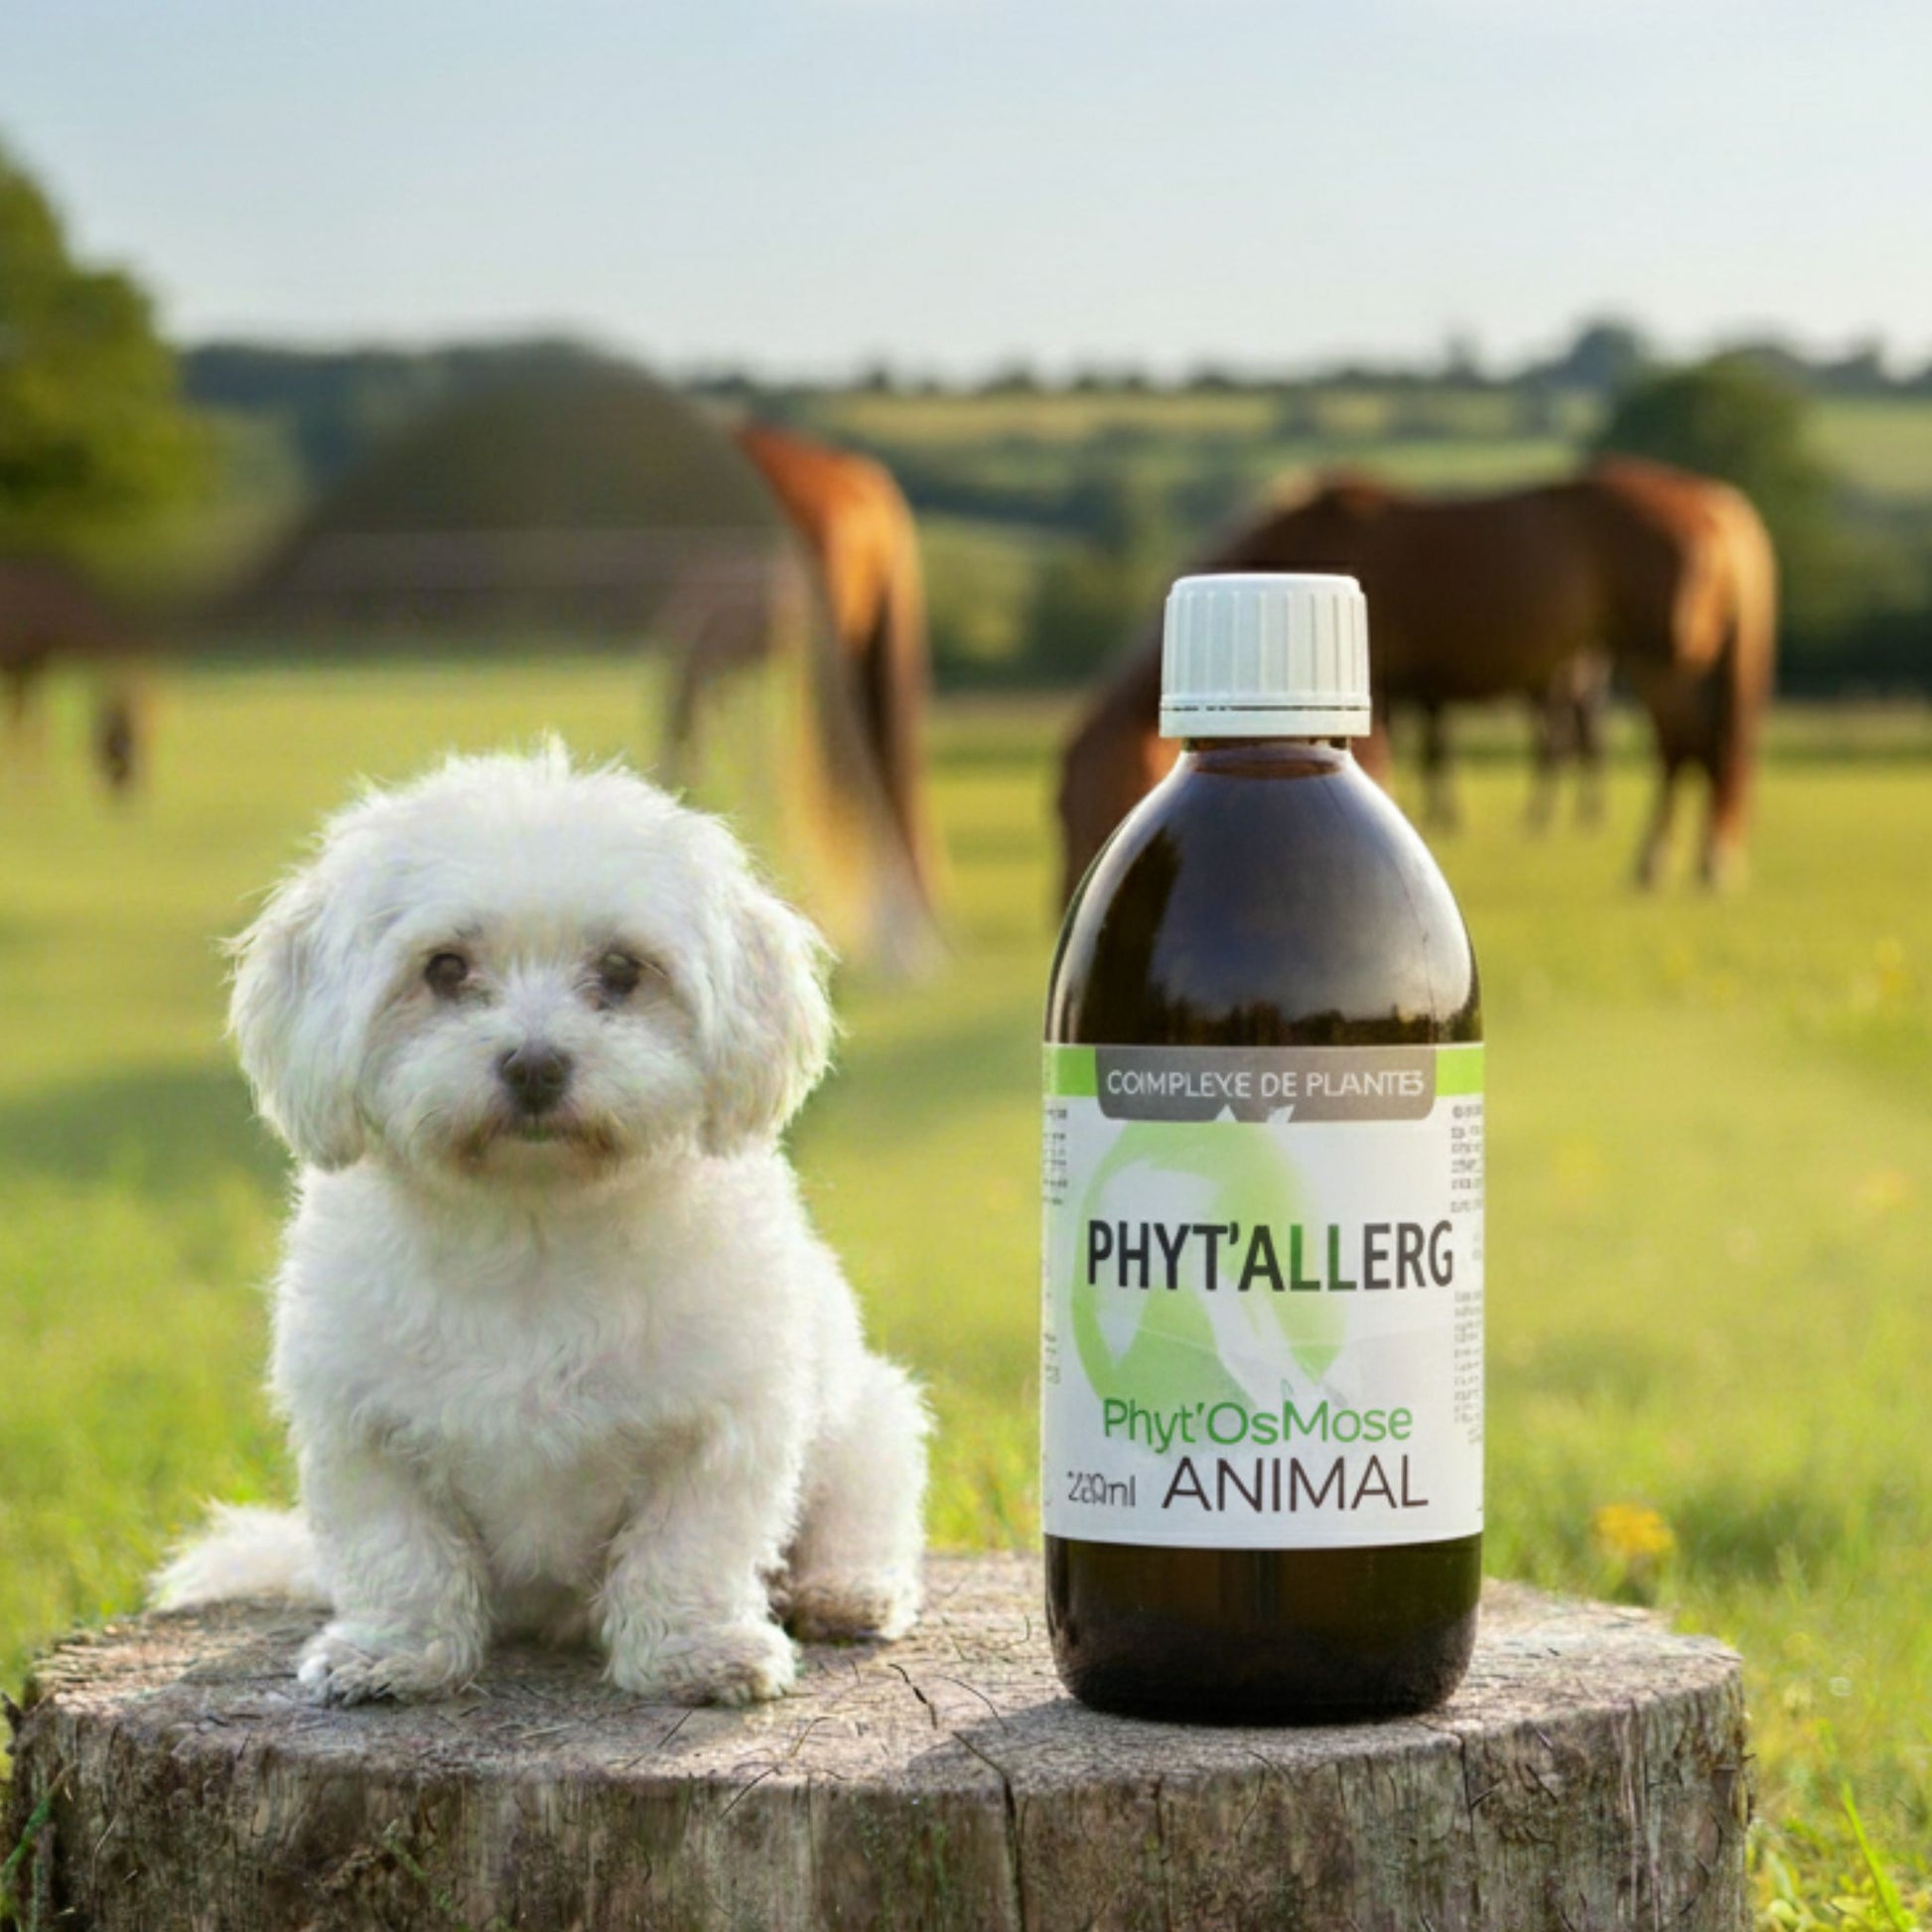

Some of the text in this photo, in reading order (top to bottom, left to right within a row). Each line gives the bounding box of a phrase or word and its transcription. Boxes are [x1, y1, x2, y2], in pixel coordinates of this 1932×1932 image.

[1260, 1071, 1298, 1097] DE
[1306, 1070, 1426, 1097] PLANTES
[1087, 1219, 1454, 1292] PHYT'ALLERG
[1102, 1398, 1414, 1454] Phyt'OsMose
[1161, 1454, 1430, 1512] ANIMAL
